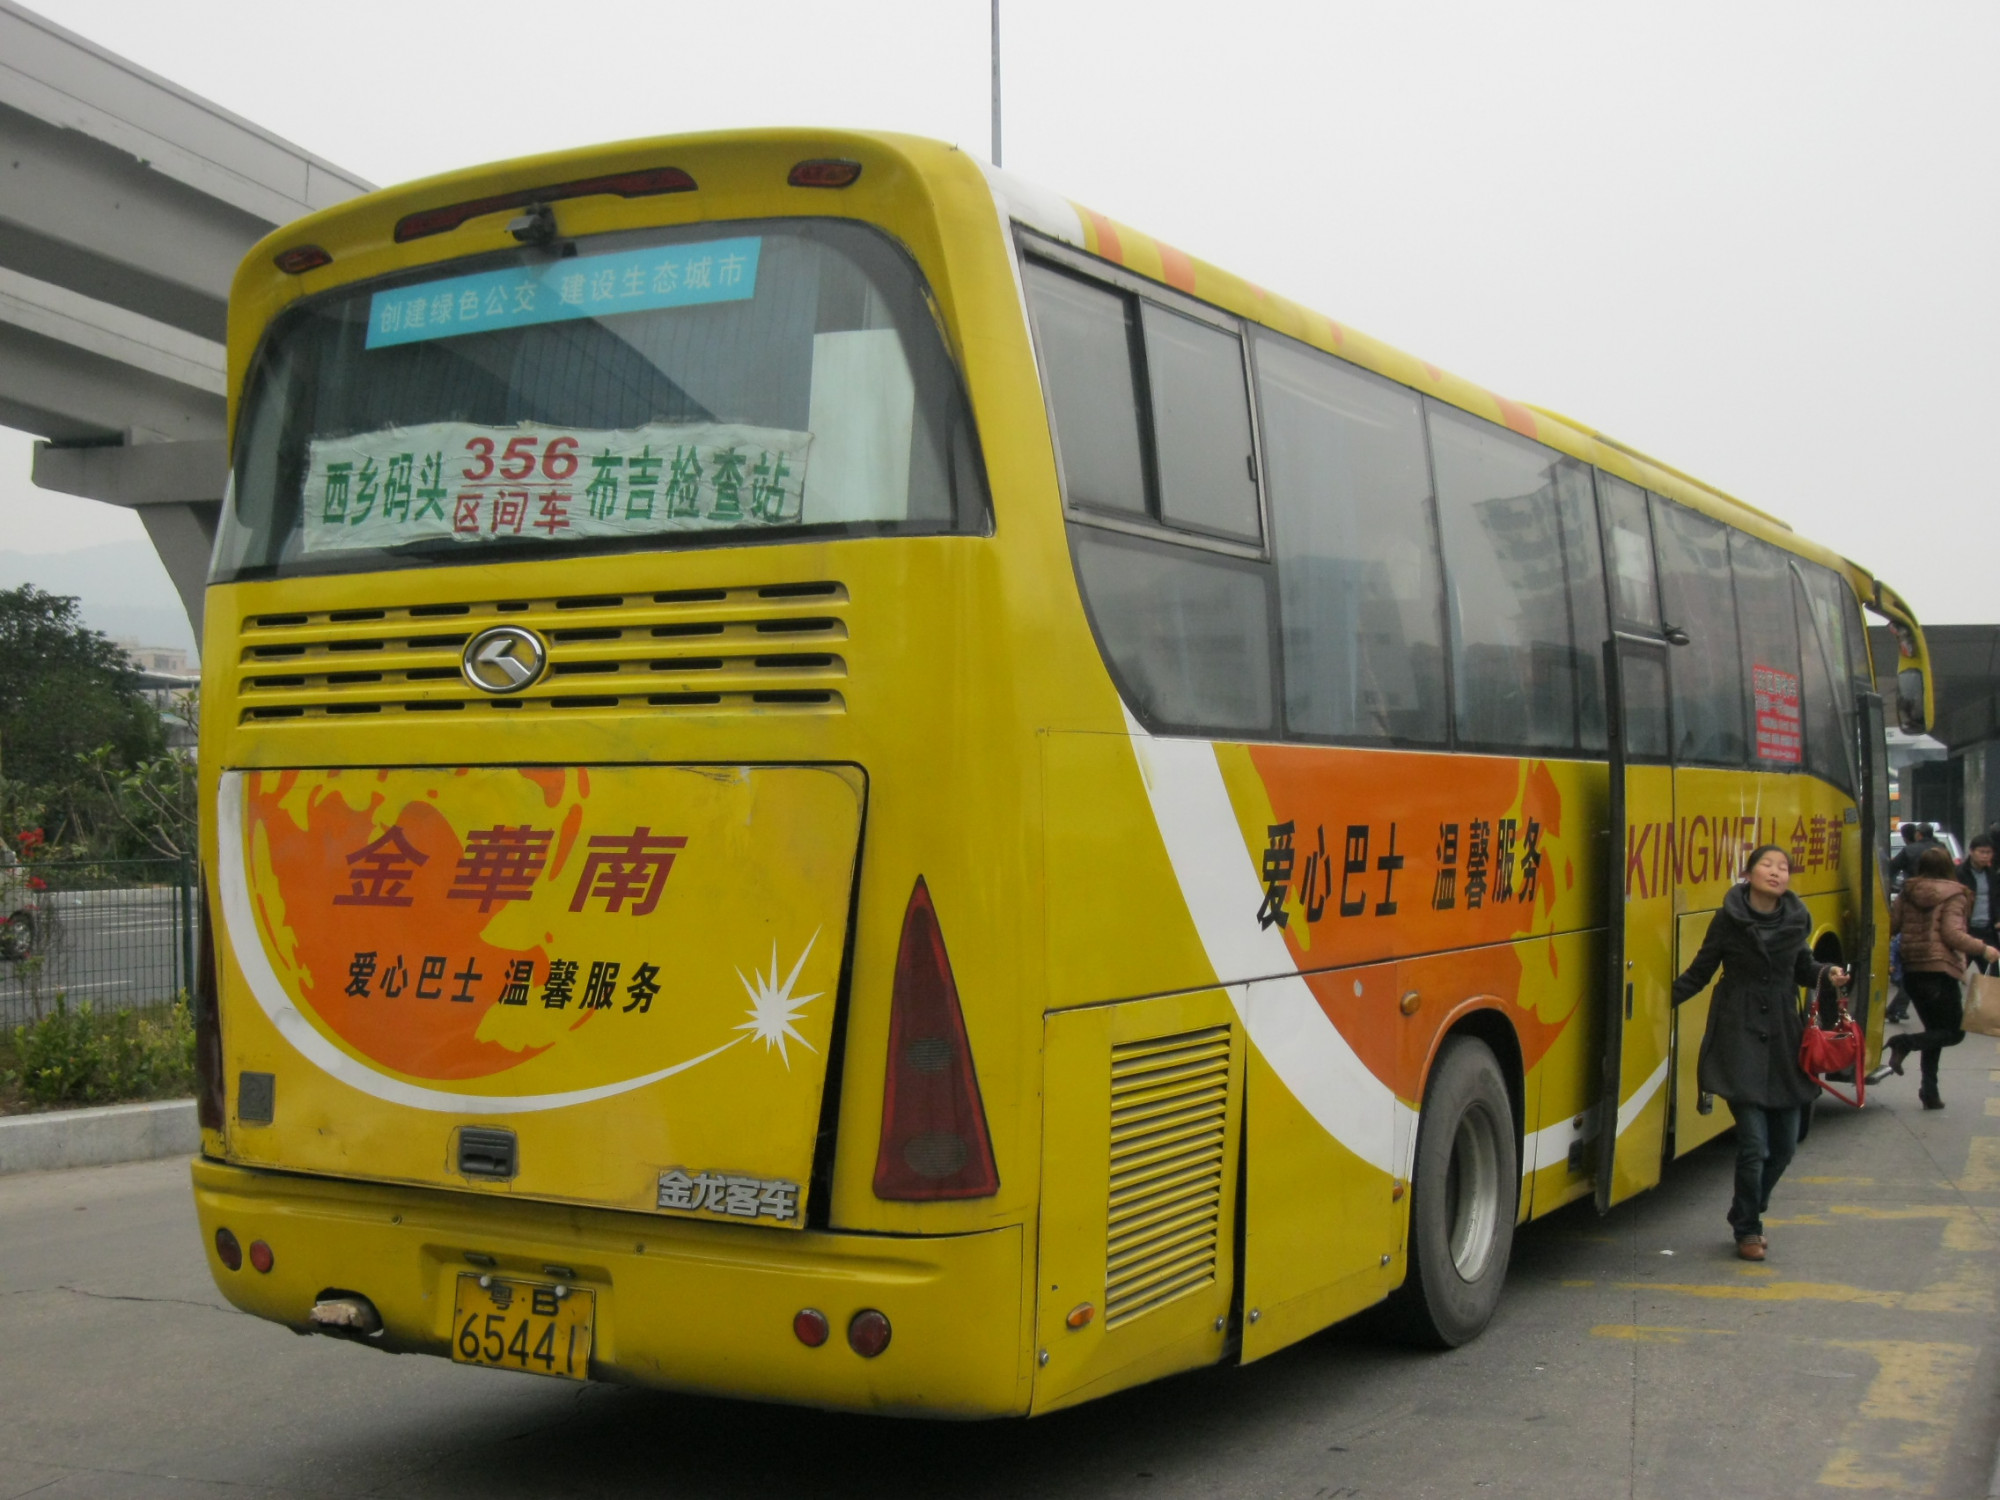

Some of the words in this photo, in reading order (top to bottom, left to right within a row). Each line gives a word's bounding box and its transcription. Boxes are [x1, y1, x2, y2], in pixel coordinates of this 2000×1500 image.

[381, 280, 537, 333] 创建绿色公交
[560, 252, 747, 306] 建设生态城市
[323, 451, 448, 525] 西乡码头
[462, 437, 578, 480] 356
[585, 445, 790, 522] 布吉检查站
[453, 489, 572, 534] 区间车
[333, 824, 688, 915] 金華南
[1256, 819, 1404, 931] 爱心巴士
[1431, 816, 1542, 911] 温馨服务
[1790, 814, 1843, 874] 金華南
[344, 951, 482, 1003] 爱心巴士
[499, 959, 661, 1014] 温馨服务
[659, 1170, 797, 1220] 金龙客车
[459, 1313, 575, 1373] 65441
